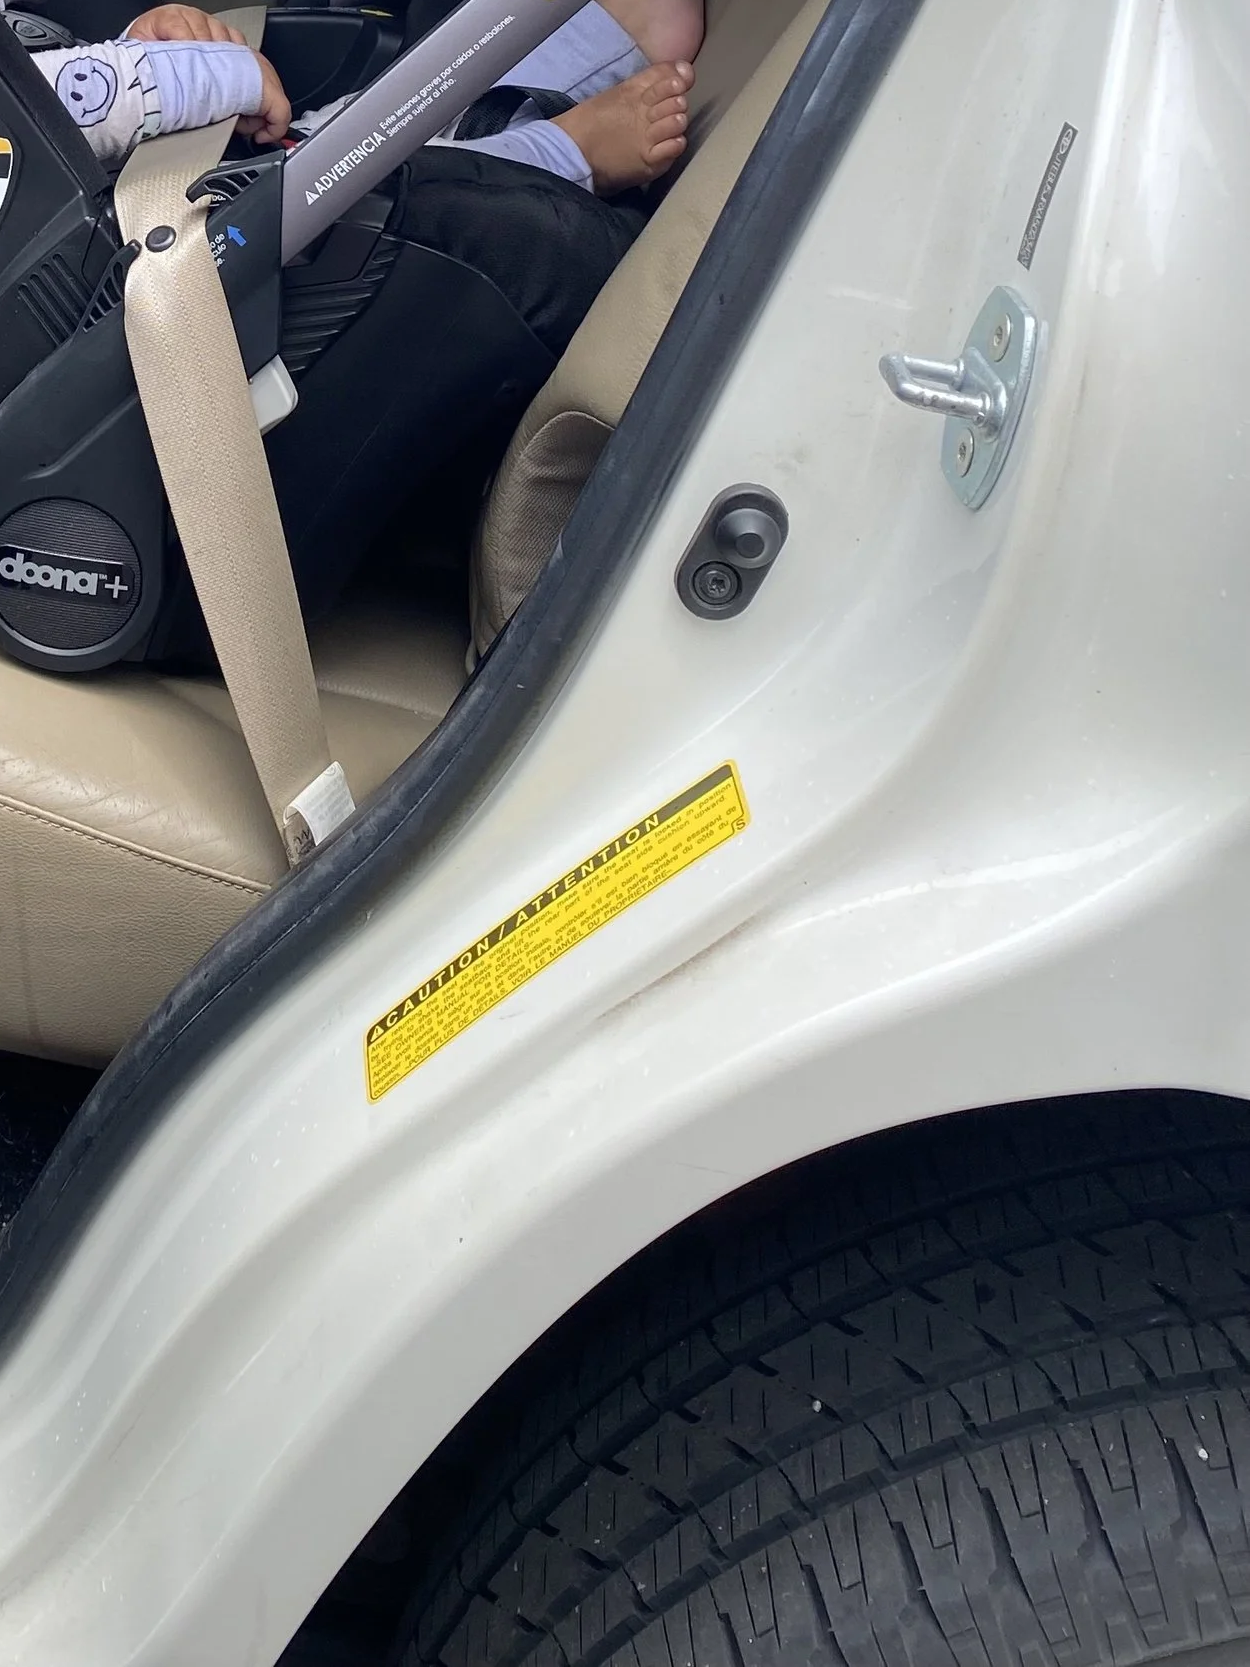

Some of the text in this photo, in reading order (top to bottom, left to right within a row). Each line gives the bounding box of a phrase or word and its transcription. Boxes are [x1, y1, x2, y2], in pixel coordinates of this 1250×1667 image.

[379, 115, 396, 130] Evite
[394, 94, 421, 117] lesiones
[419, 76, 442, 97] graves
[440, 66, 453, 80] por
[478, 14, 516, 46] resbalones.
[386, 114, 413, 137] Siempre
[412, 96, 434, 116] sujetar
[432, 89, 441, 98] al
[314, 131, 386, 195] ADVERTENCIA
[736, 818, 746, 831] S
[386, 937, 489, 1027] CAUTION
[516, 814, 659, 927] ATTENTION
[436, 990, 469, 1018] MANUAL
